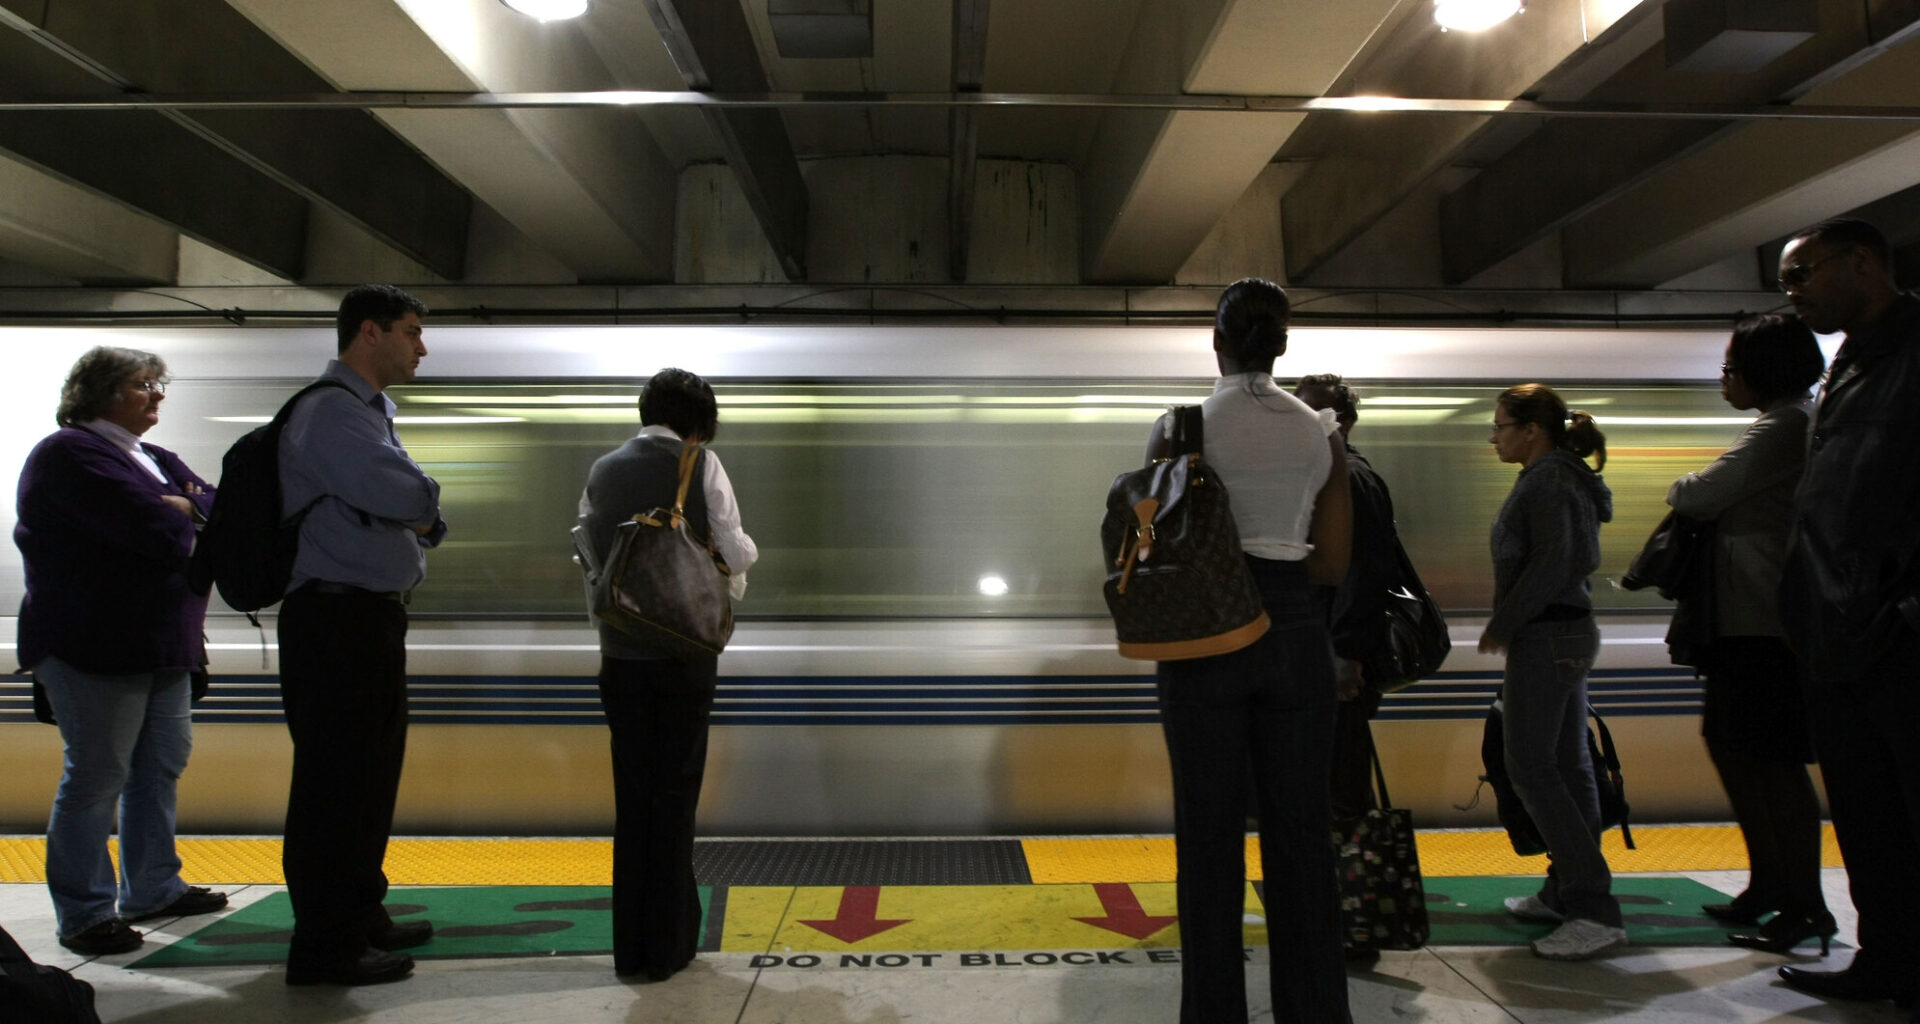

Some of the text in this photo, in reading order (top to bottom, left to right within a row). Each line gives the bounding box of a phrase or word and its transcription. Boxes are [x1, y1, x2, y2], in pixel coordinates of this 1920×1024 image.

[749, 953, 821, 968] DO
[839, 953, 942, 968] NOT
[960, 951, 1134, 967] BLOCK
